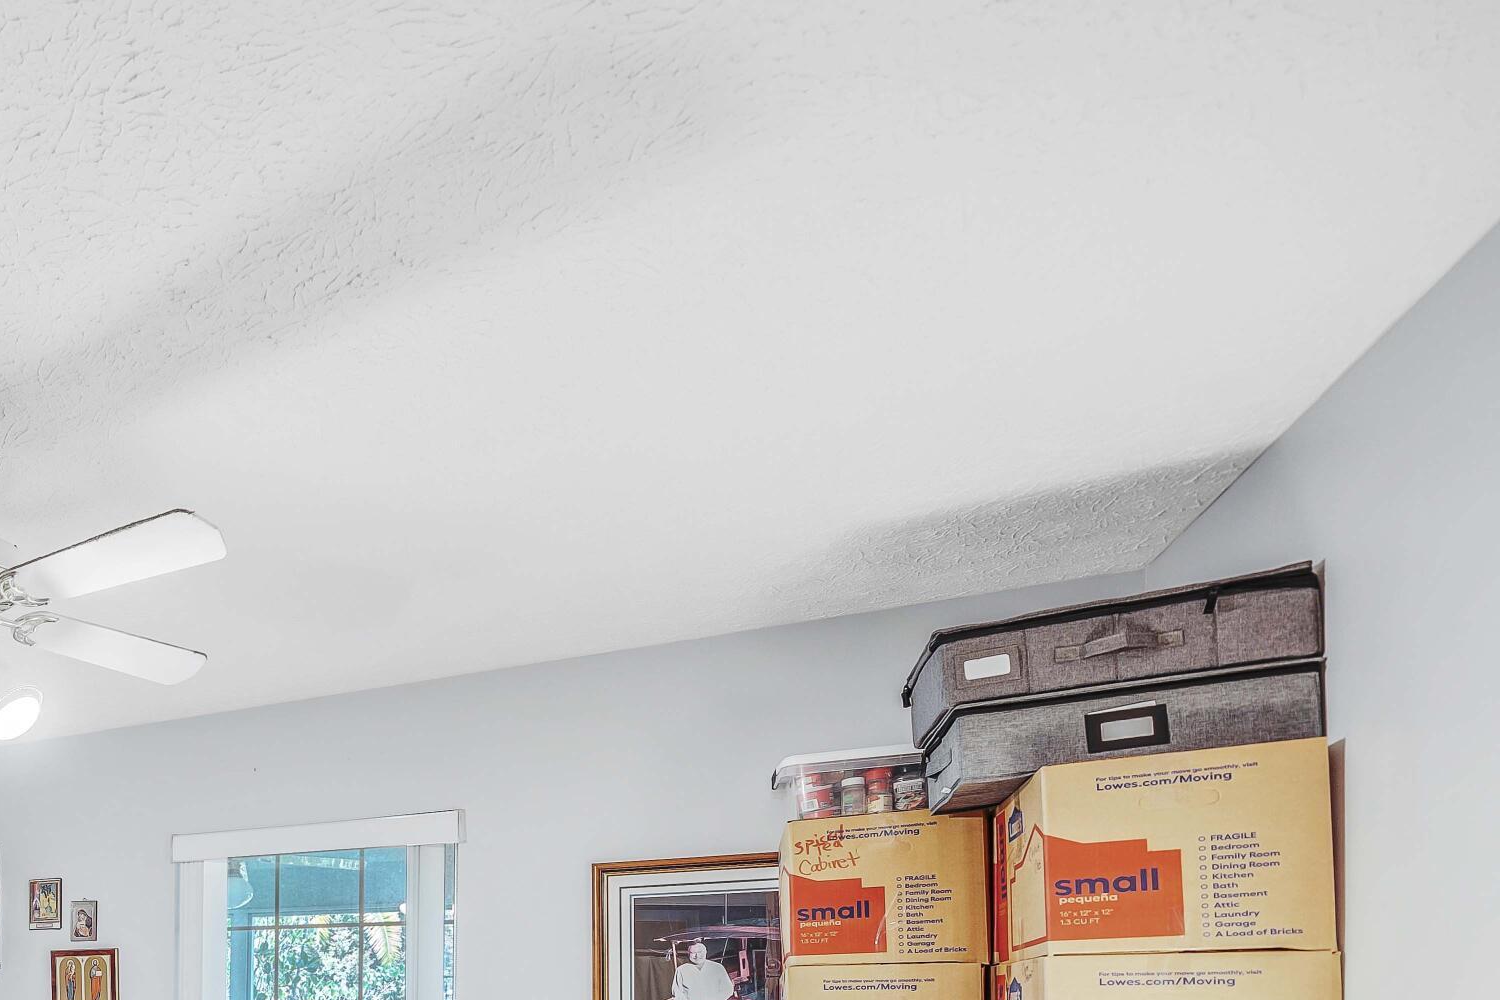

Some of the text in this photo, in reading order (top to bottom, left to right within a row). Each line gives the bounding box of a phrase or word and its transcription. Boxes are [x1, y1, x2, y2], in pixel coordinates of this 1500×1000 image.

[1096, 771, 1233, 792] Lowes.com/Moving
[827, 828, 920, 841] Lowes.com/Moving
[1210, 832, 1257, 842] FRAGILE
[1210, 842, 1260, 851] Bedroom
[1211, 850, 1281, 861] Family Room
[1211, 860, 1281, 871] Dining Room
[1212, 871, 1254, 880] Kitchen
[1054, 868, 1160, 896] small
[1059, 892, 1118, 906] pequeña
[1213, 890, 1268, 899] Basement
[797, 900, 869, 922] small
[1214, 910, 1260, 920] Laundry
[800, 920, 841, 928] pequeña
[1215, 920, 1257, 928] Garage
[1226, 929, 1254, 937] Load
[1270, 927, 1303, 935] Bricks
[1099, 976, 1236, 987] Lowes.com/Moving
[823, 983, 917, 991] Lowes.com/Moving
